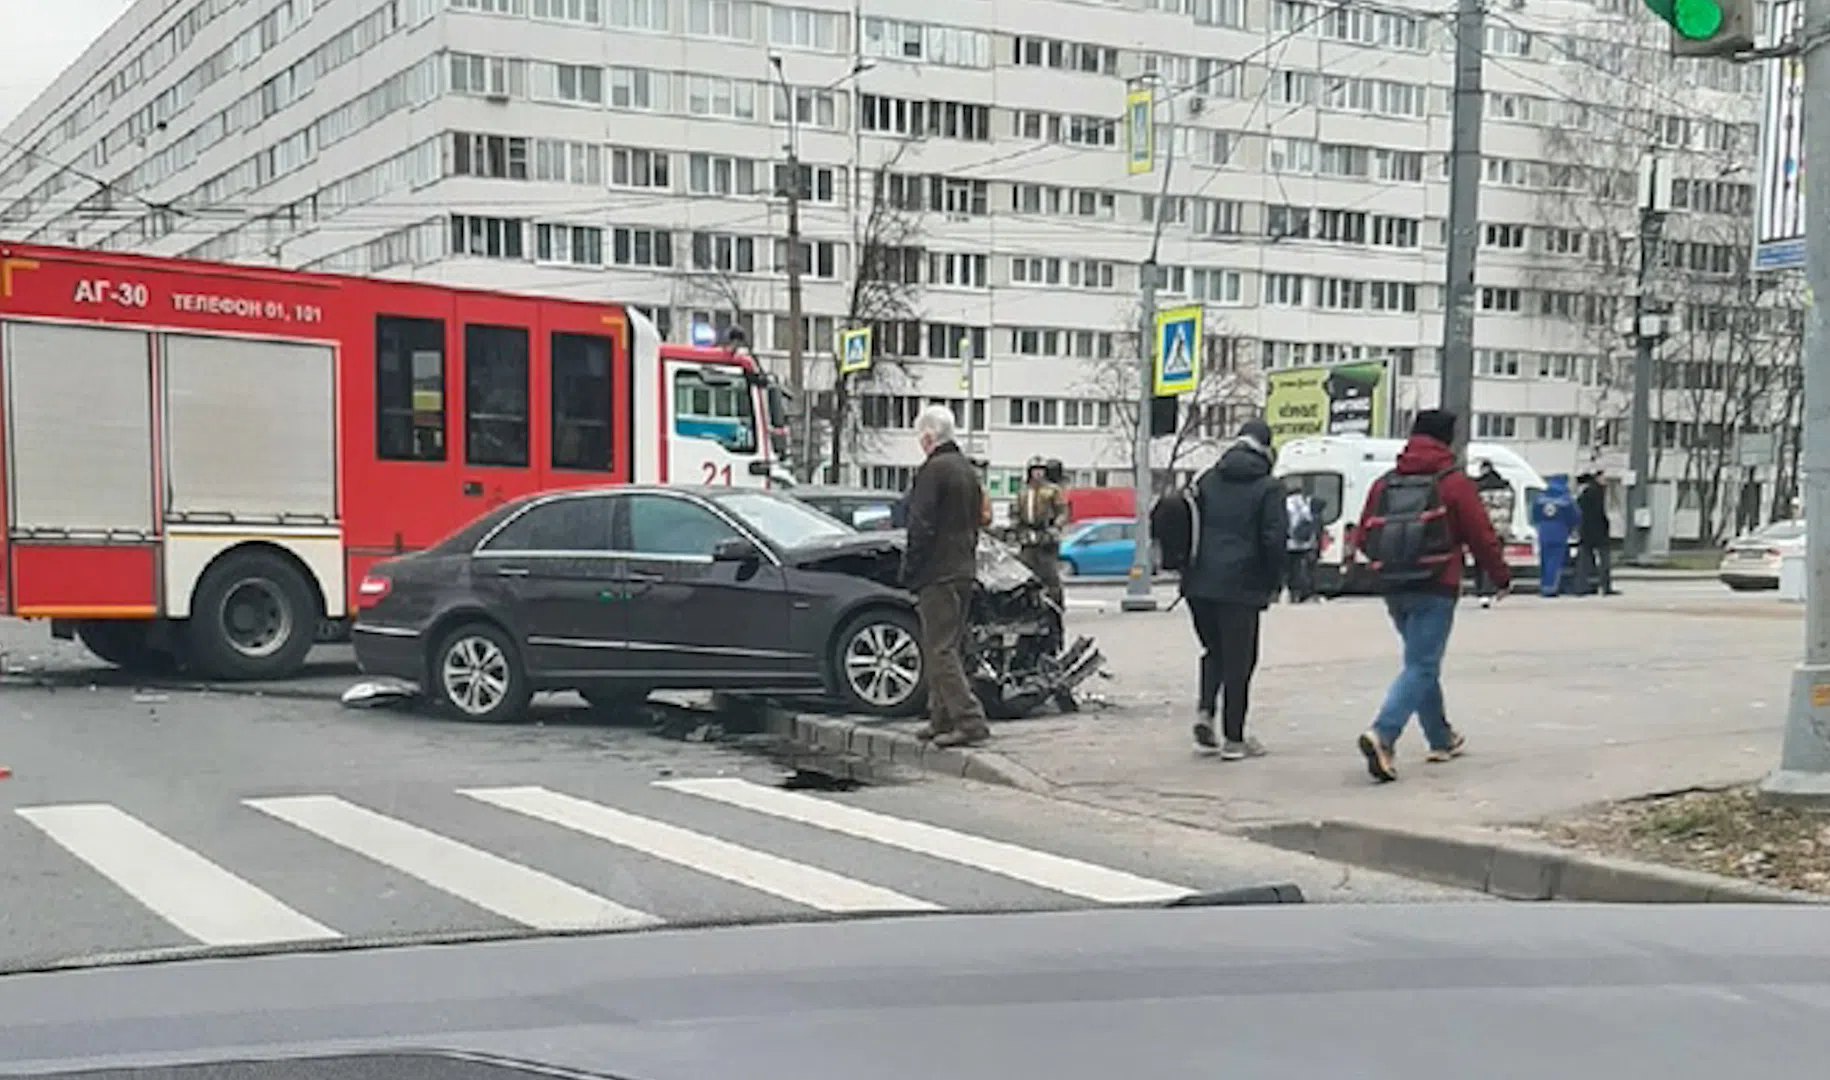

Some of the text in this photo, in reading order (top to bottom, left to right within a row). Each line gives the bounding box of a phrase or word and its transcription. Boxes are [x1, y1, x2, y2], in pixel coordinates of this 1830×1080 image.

[74, 279, 149, 308] АГ-30
[172, 293, 322, 323] ТЕЛЕФОН 01, 101
[702, 462, 732, 487] 21
